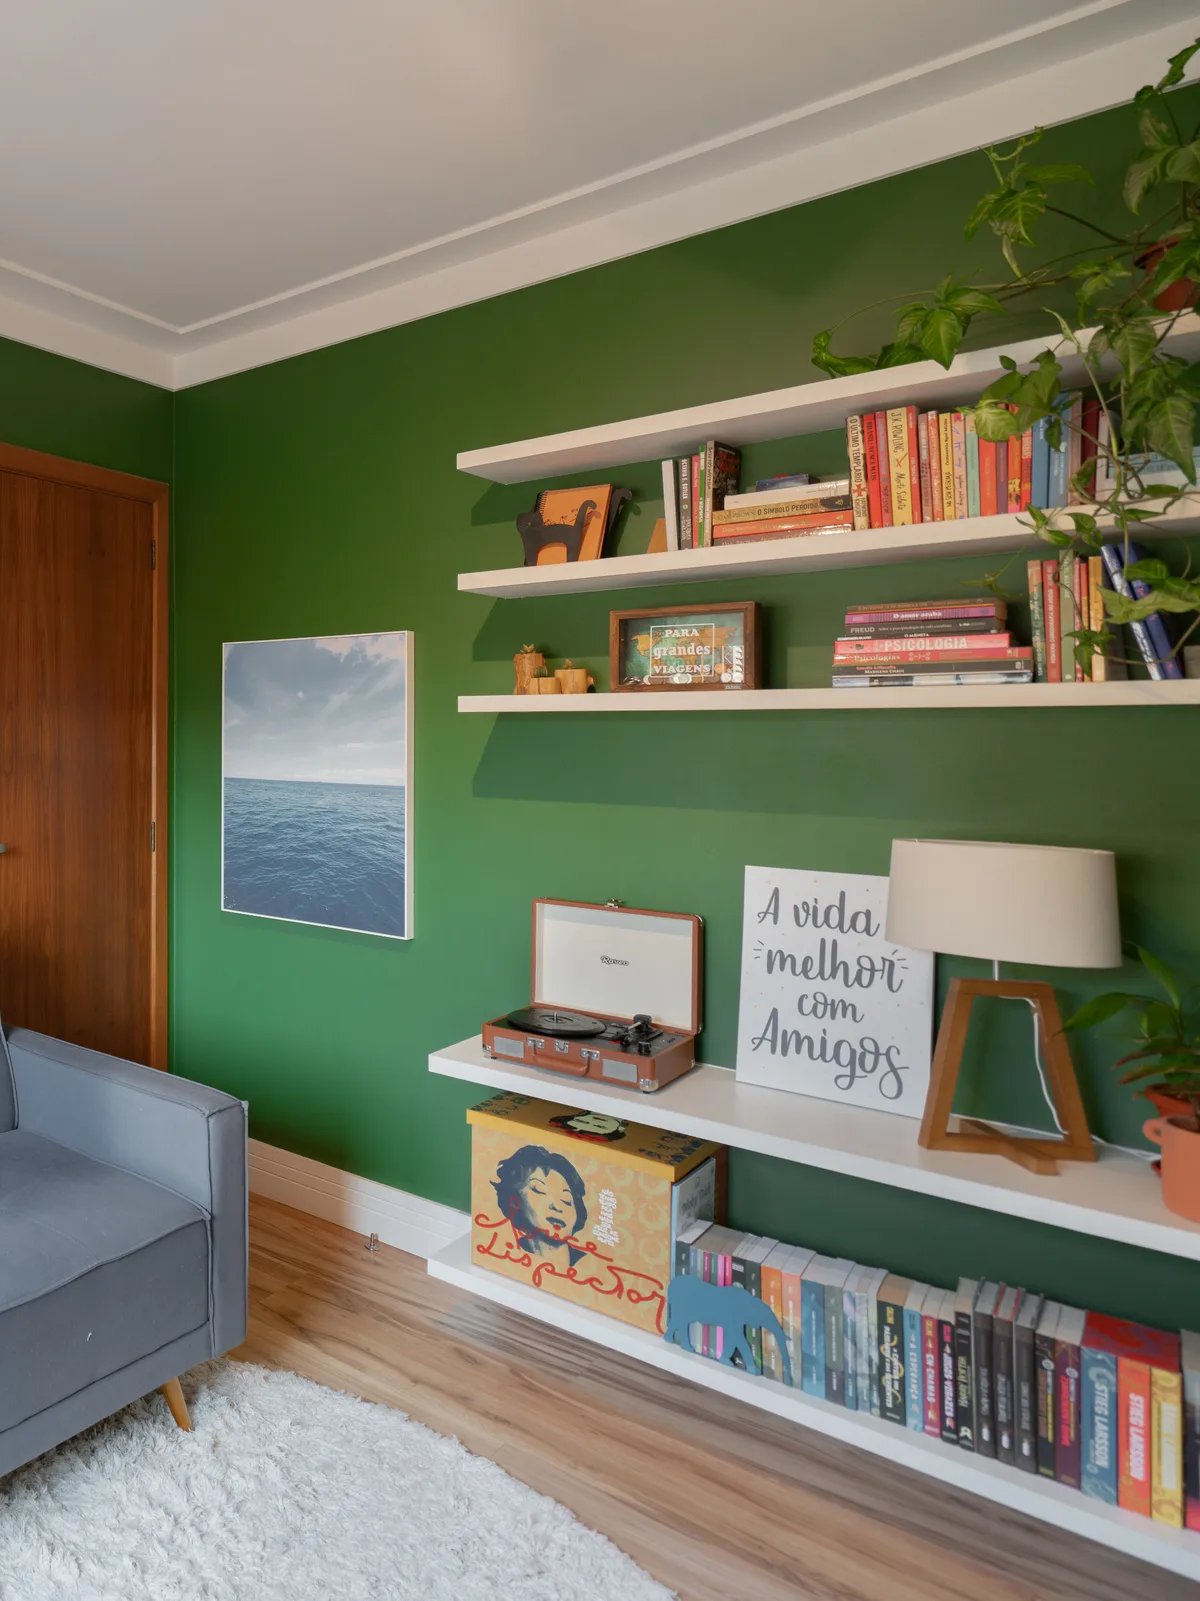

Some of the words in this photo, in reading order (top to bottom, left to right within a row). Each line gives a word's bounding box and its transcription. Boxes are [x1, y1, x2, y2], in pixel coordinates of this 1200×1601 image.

[681, 458, 689, 477] OCTAVIA
[681, 483, 689, 500] BUTLER
[763, 506, 790, 516] SÍMBOLO
[664, 628, 700, 638] PARA
[850, 626, 875, 634] FREUD
[884, 638, 968, 651] PSICOLOGIA
[653, 642, 711, 660] grandes
[854, 654, 900, 662] Psicologias
[653, 664, 711, 674] VIAGENS
[757, 887, 781, 926] A
[793, 890, 880, 938] vida
[765, 938, 904, 994] melhor
[797, 990, 865, 1024] com
[751, 1006, 910, 1100] Amigos
[474, 1195, 613, 1262] Clarice
[476, 1232, 665, 1335] Lispector
[942, 1352, 953, 1379] JOGOS
[926, 1367, 936, 1403] CHAMAS
[944, 1380, 954, 1418] VORAZES
[1094, 1383, 1110, 1415] STIEG
[1129, 1393, 1145, 1427] STIEG
[1160, 1401, 1178, 1436] STIEG
[1094, 1415, 1110, 1470] LARSSON
[1129, 1427, 1145, 1481] LARSSON
